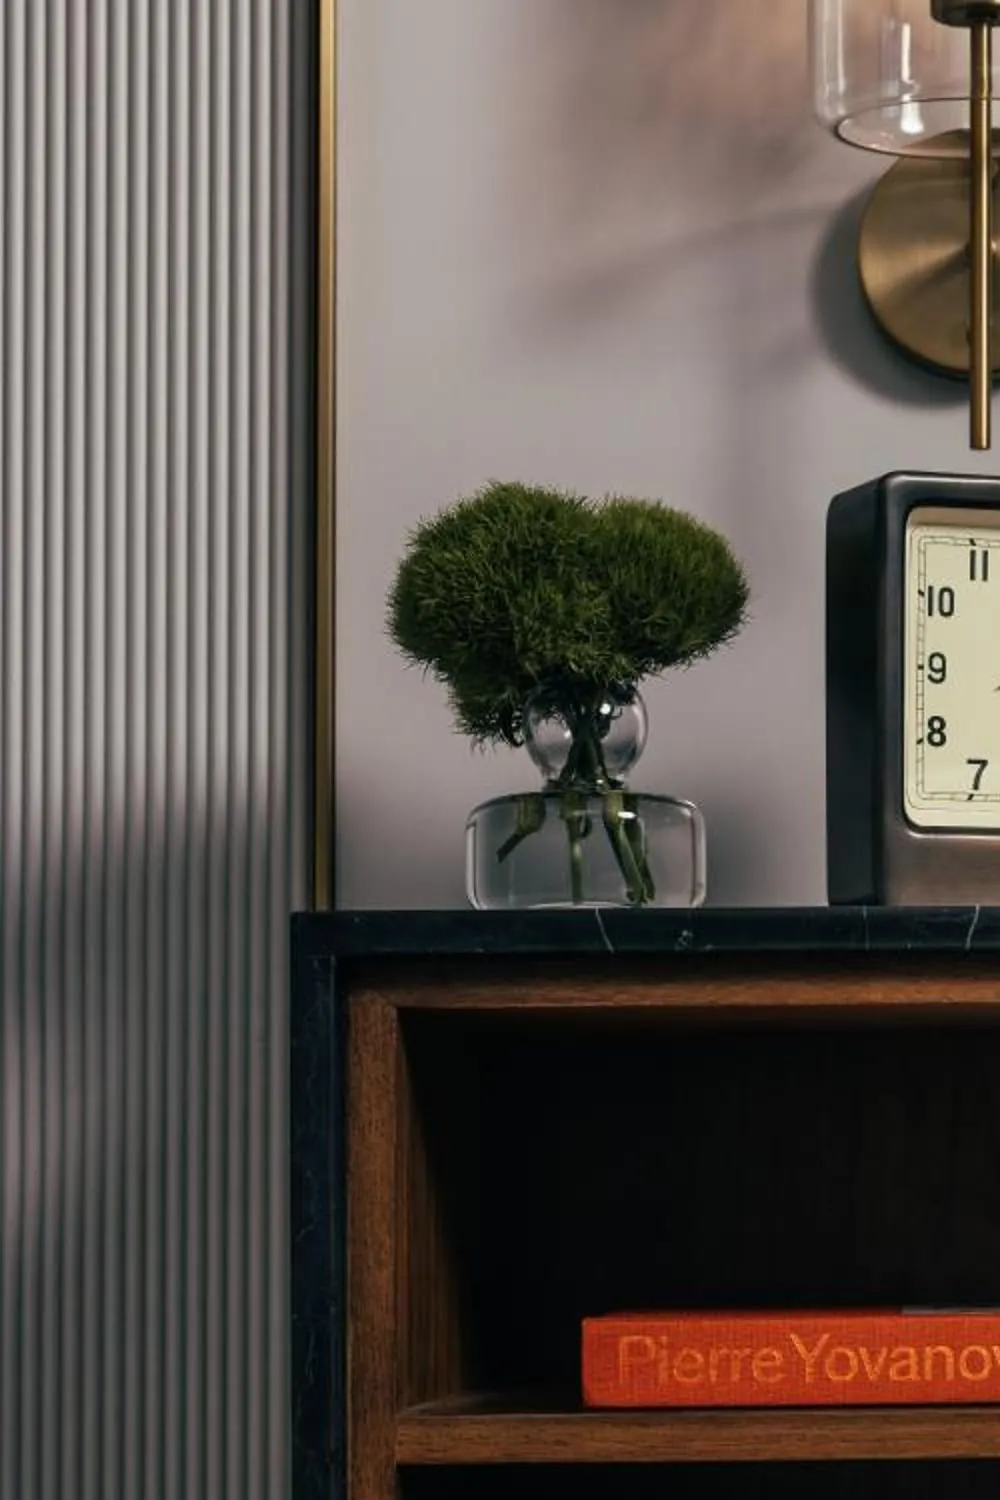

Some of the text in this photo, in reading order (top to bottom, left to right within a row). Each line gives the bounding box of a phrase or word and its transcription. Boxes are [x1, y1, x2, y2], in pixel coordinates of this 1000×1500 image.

[969, 550, 989, 582] 11
[927, 585, 955, 617] 10
[927, 652, 947, 684] 9
[926, 715, 947, 747] 8
[966, 758, 989, 790] 7
